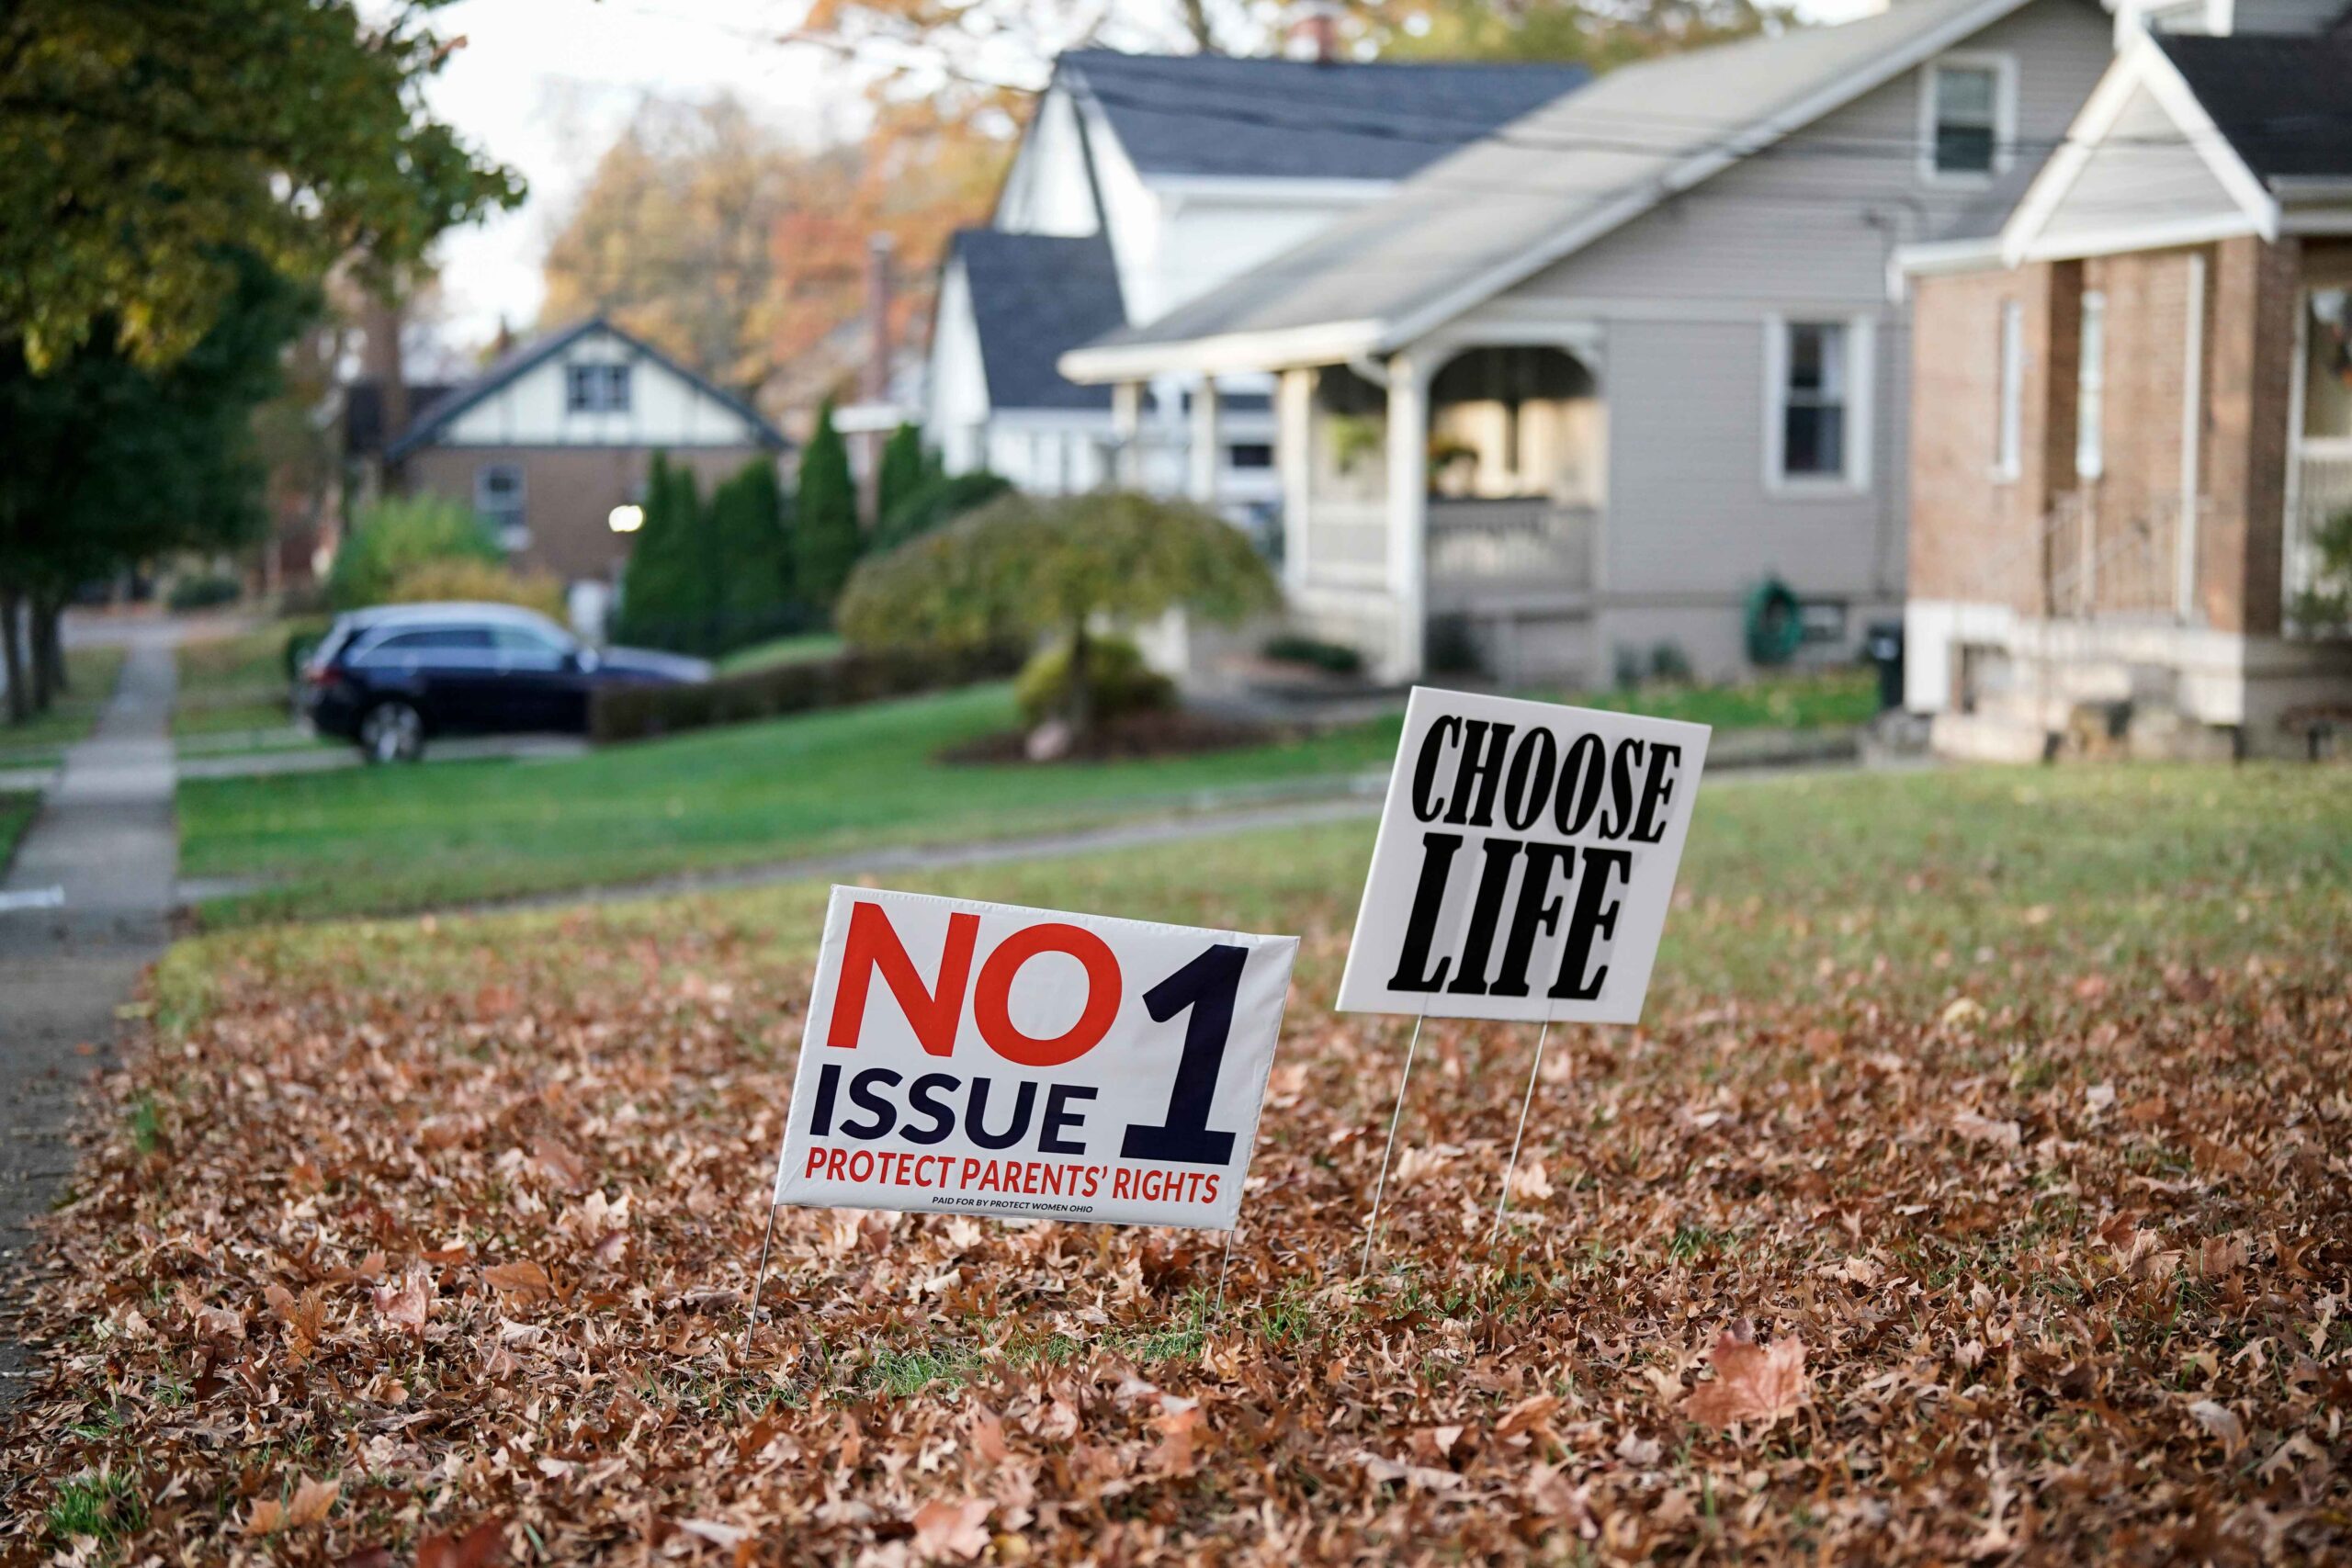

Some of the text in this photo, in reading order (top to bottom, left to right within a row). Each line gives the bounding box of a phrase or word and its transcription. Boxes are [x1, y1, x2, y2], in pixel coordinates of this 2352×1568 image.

[1412, 715, 1681, 843] CHOOSE
[827, 901, 1123, 1067] NO
[1386, 832, 1632, 1000] LIFE
[809, 944, 1249, 1166] ISSUE 1
[805, 1146, 956, 1188] PROTECT
[1112, 1168, 1221, 1205] RIGHTS
[932, 1196, 1093, 1213] PAID FOR BY PROTECT WOMEN OHIO
